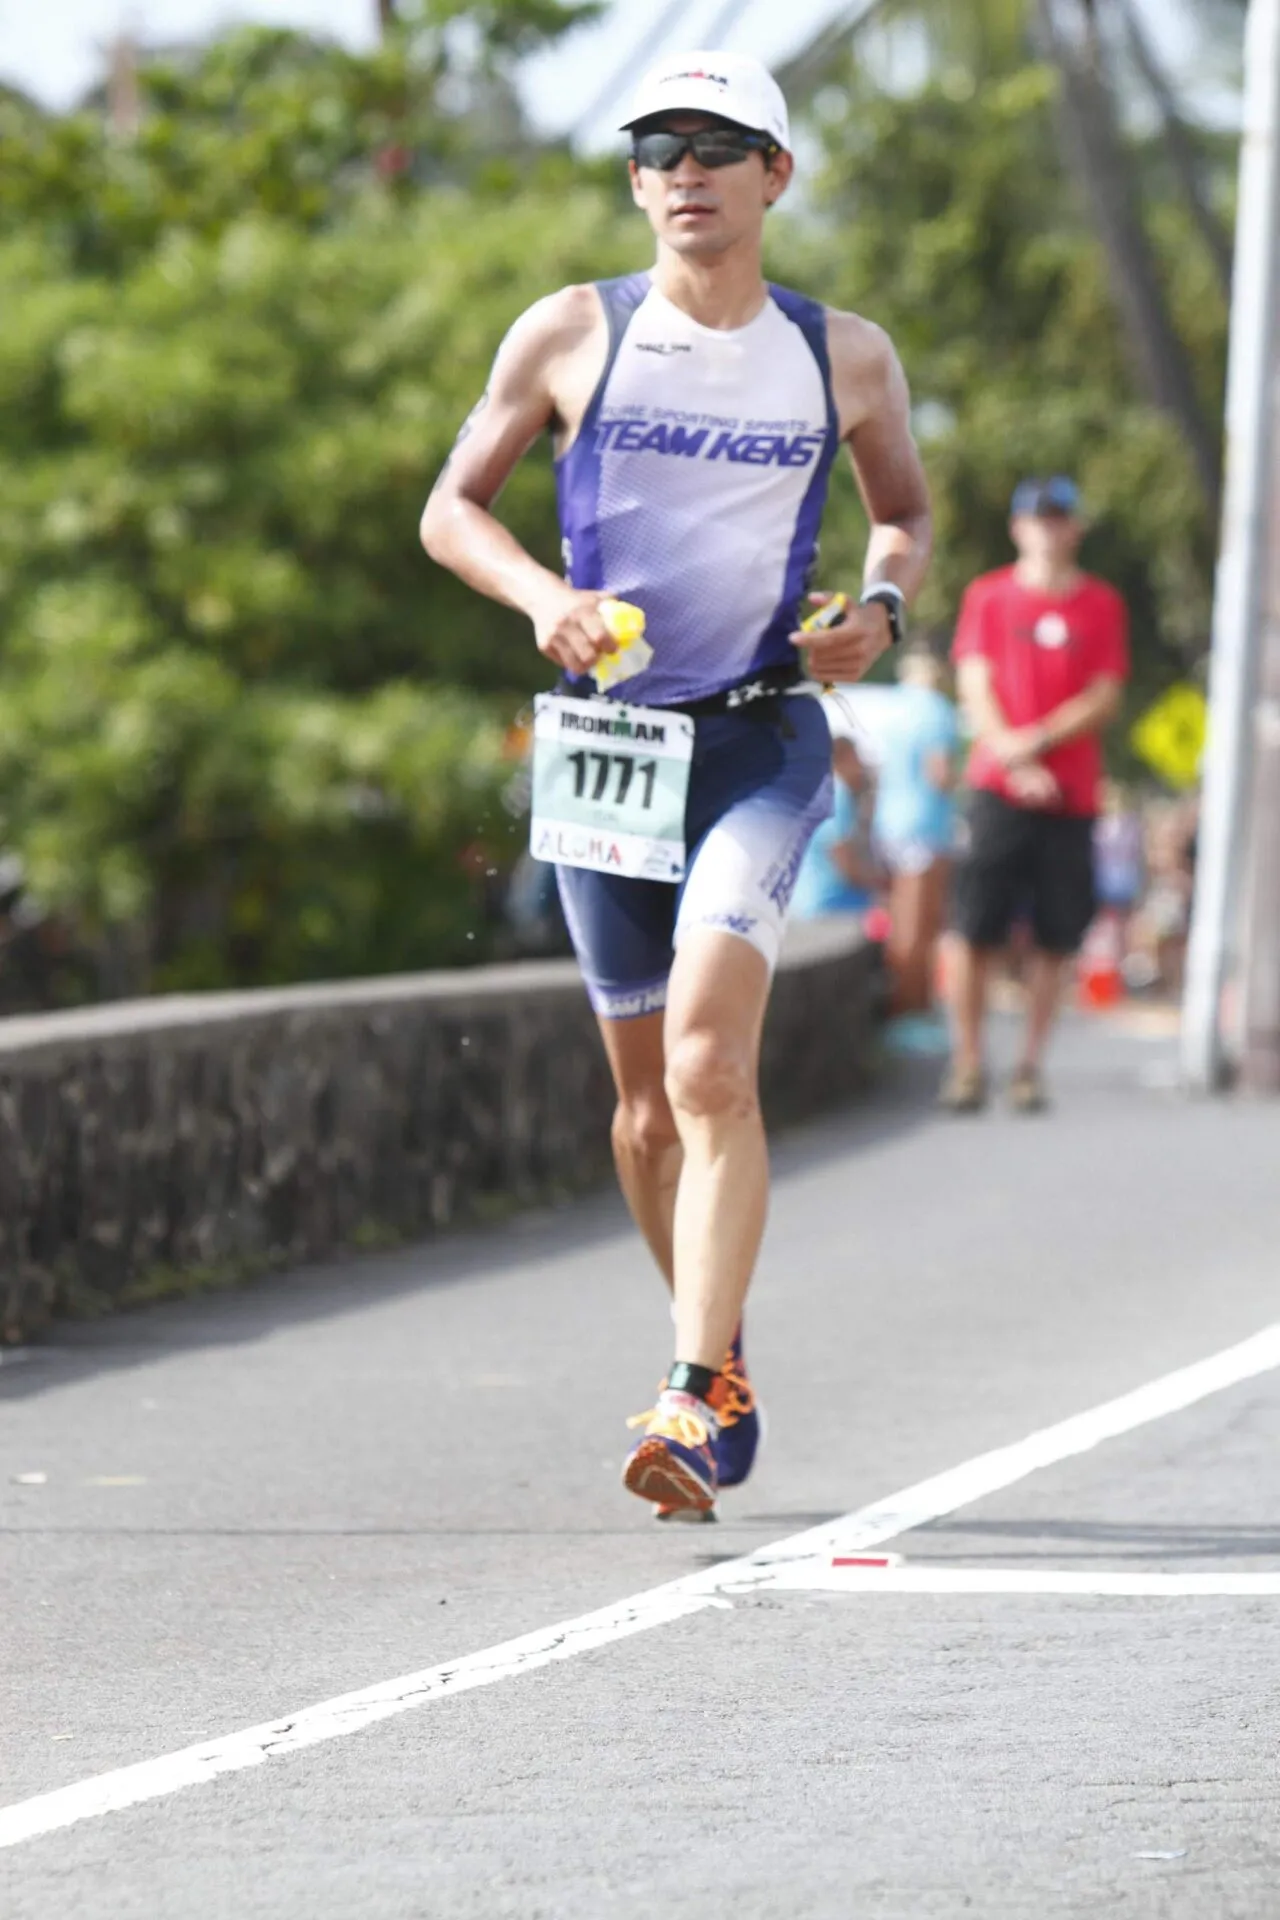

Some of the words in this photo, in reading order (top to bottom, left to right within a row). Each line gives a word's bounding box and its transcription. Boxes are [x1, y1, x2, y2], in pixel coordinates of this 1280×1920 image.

[599, 420, 710, 458] TEAM
[561, 709, 666, 743] IRONMAN
[567, 750, 657, 809] 1771
